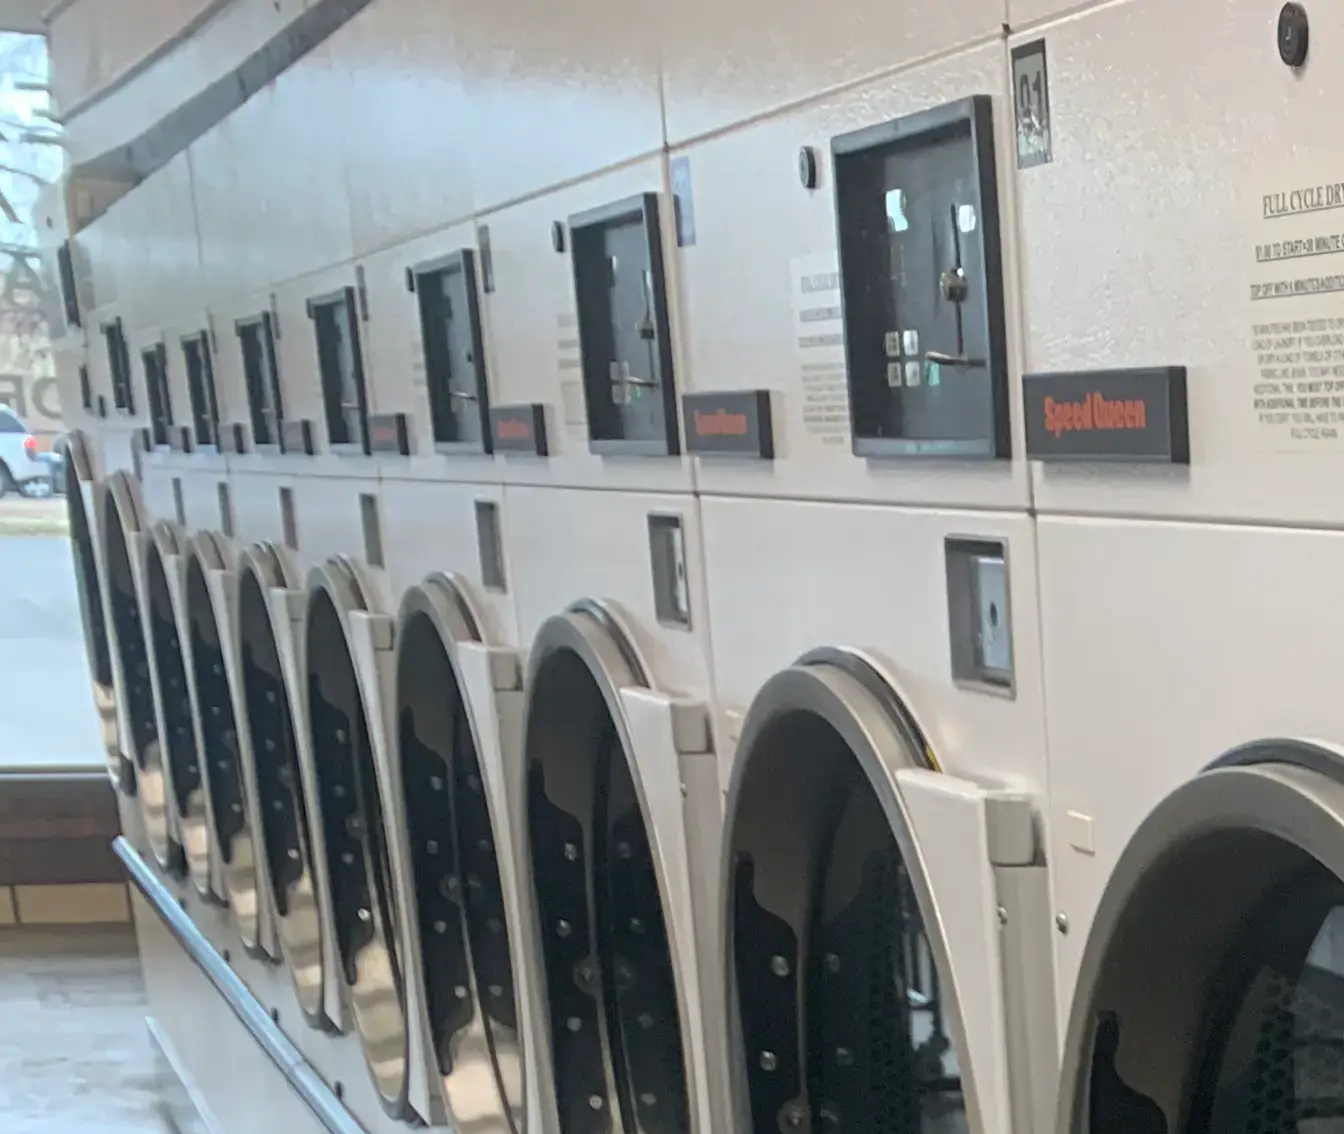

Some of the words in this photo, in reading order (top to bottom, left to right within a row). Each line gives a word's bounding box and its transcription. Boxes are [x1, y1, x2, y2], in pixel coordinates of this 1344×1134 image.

[1263, 192, 1288, 215] FULL
[1290, 186, 1323, 210] CYCLE
[1044, 391, 1092, 439] Speed
[1094, 391, 1147, 429] Queen
